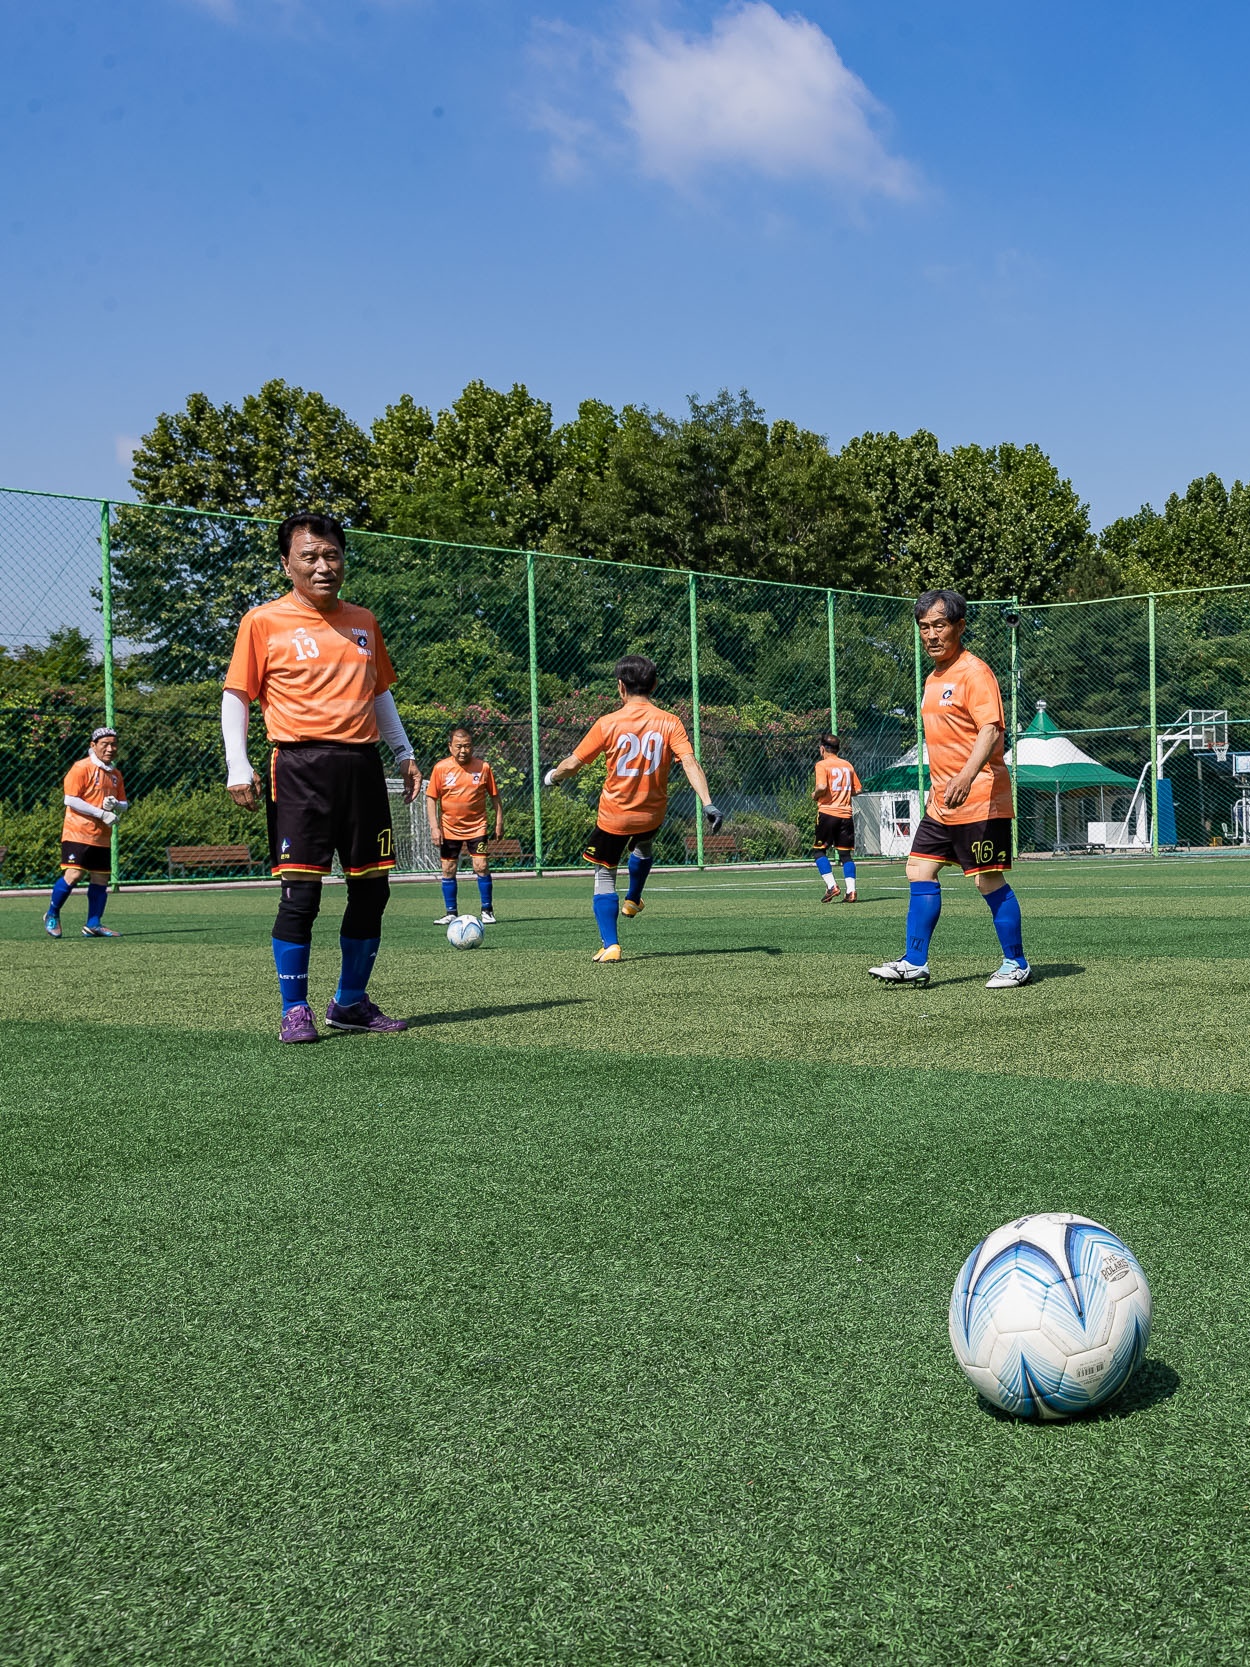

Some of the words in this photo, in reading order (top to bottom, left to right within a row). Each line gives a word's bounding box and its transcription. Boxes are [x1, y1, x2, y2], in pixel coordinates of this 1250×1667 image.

[291, 637, 320, 661] 13
[616, 729, 664, 777] 29
[377, 828, 395, 857] 1
[971, 840, 994, 864] 16
[1101, 1258, 1129, 1281] POLARIS
[1103, 1254, 1117, 1265] THE
